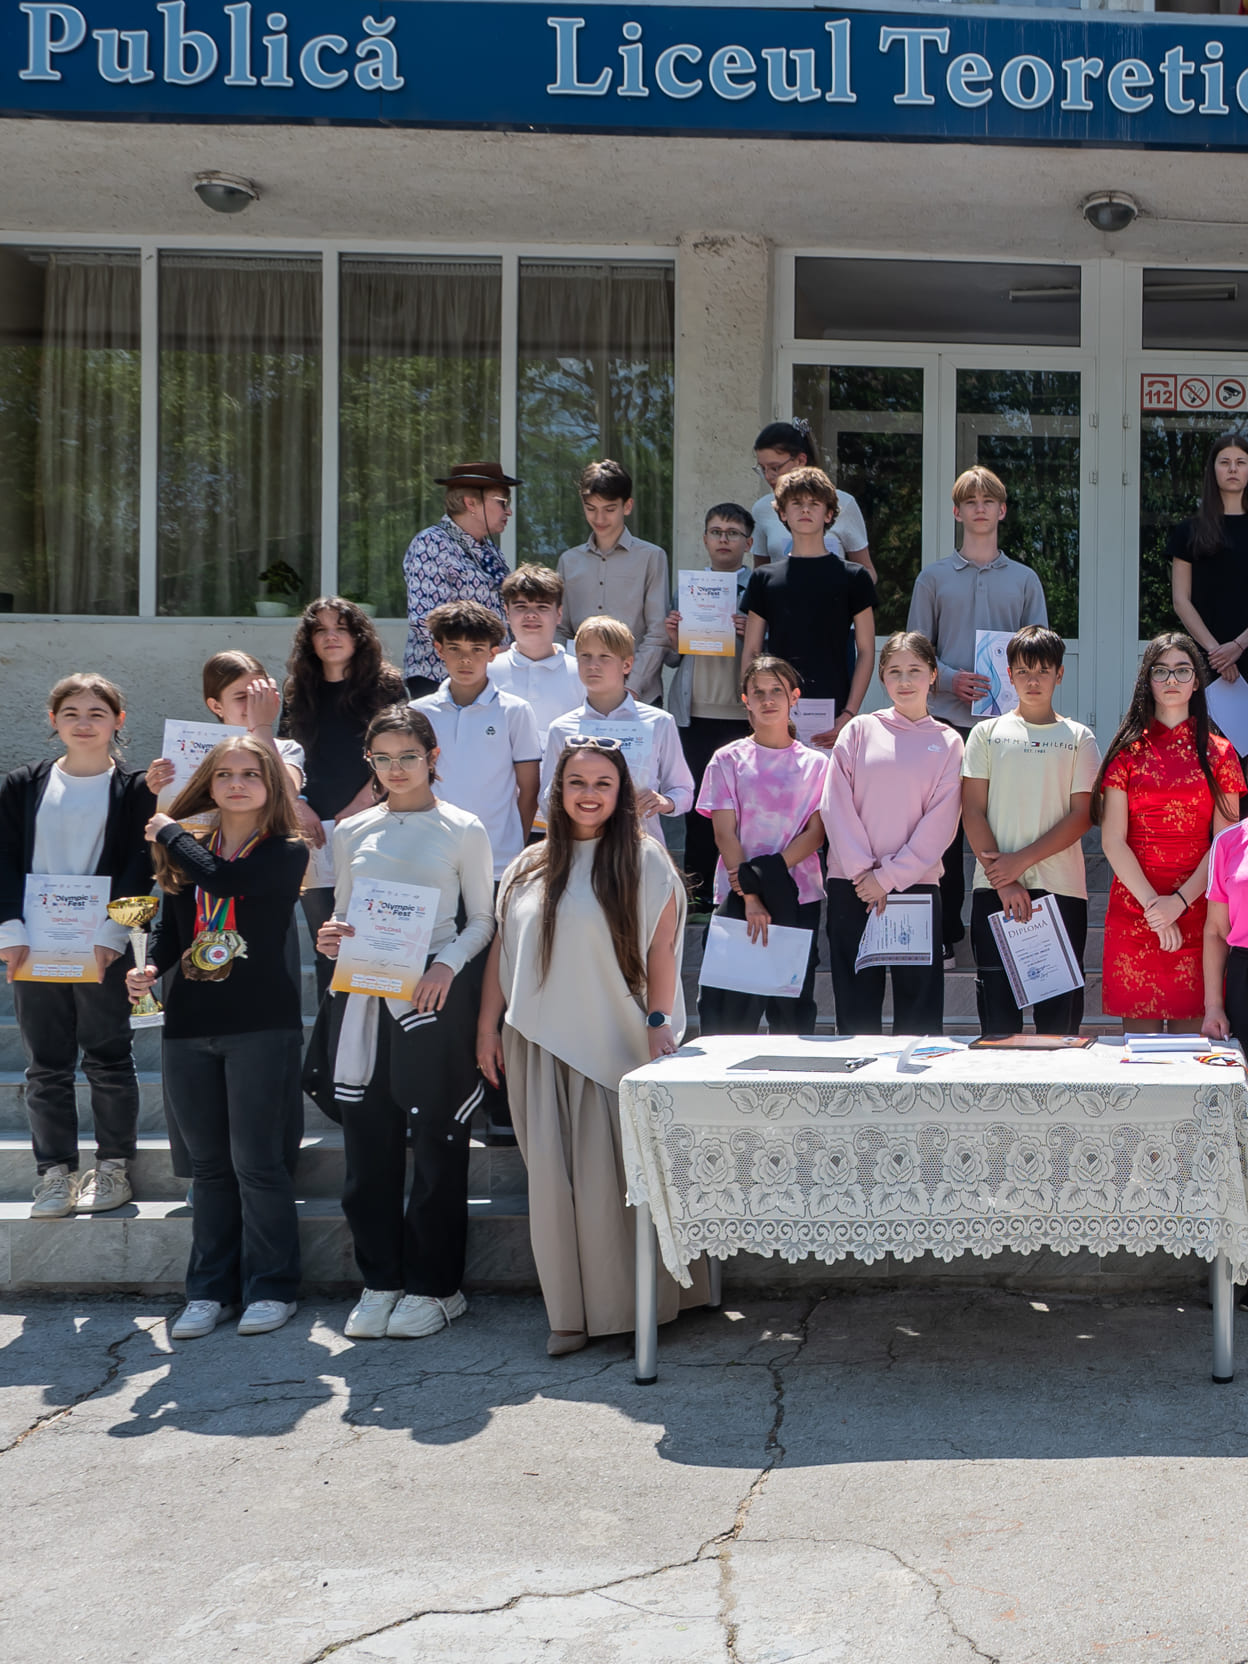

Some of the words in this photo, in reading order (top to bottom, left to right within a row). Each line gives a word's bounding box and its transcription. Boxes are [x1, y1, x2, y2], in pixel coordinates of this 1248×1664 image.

[18, 0, 405, 91] Publică
[546, 17, 856, 103] Liceul
[1145, 390, 1173, 405] 112
[987, 737, 1029, 747] TOMMY
[56, 893, 89, 902] Olympic
[381, 902, 416, 912] Olympic
